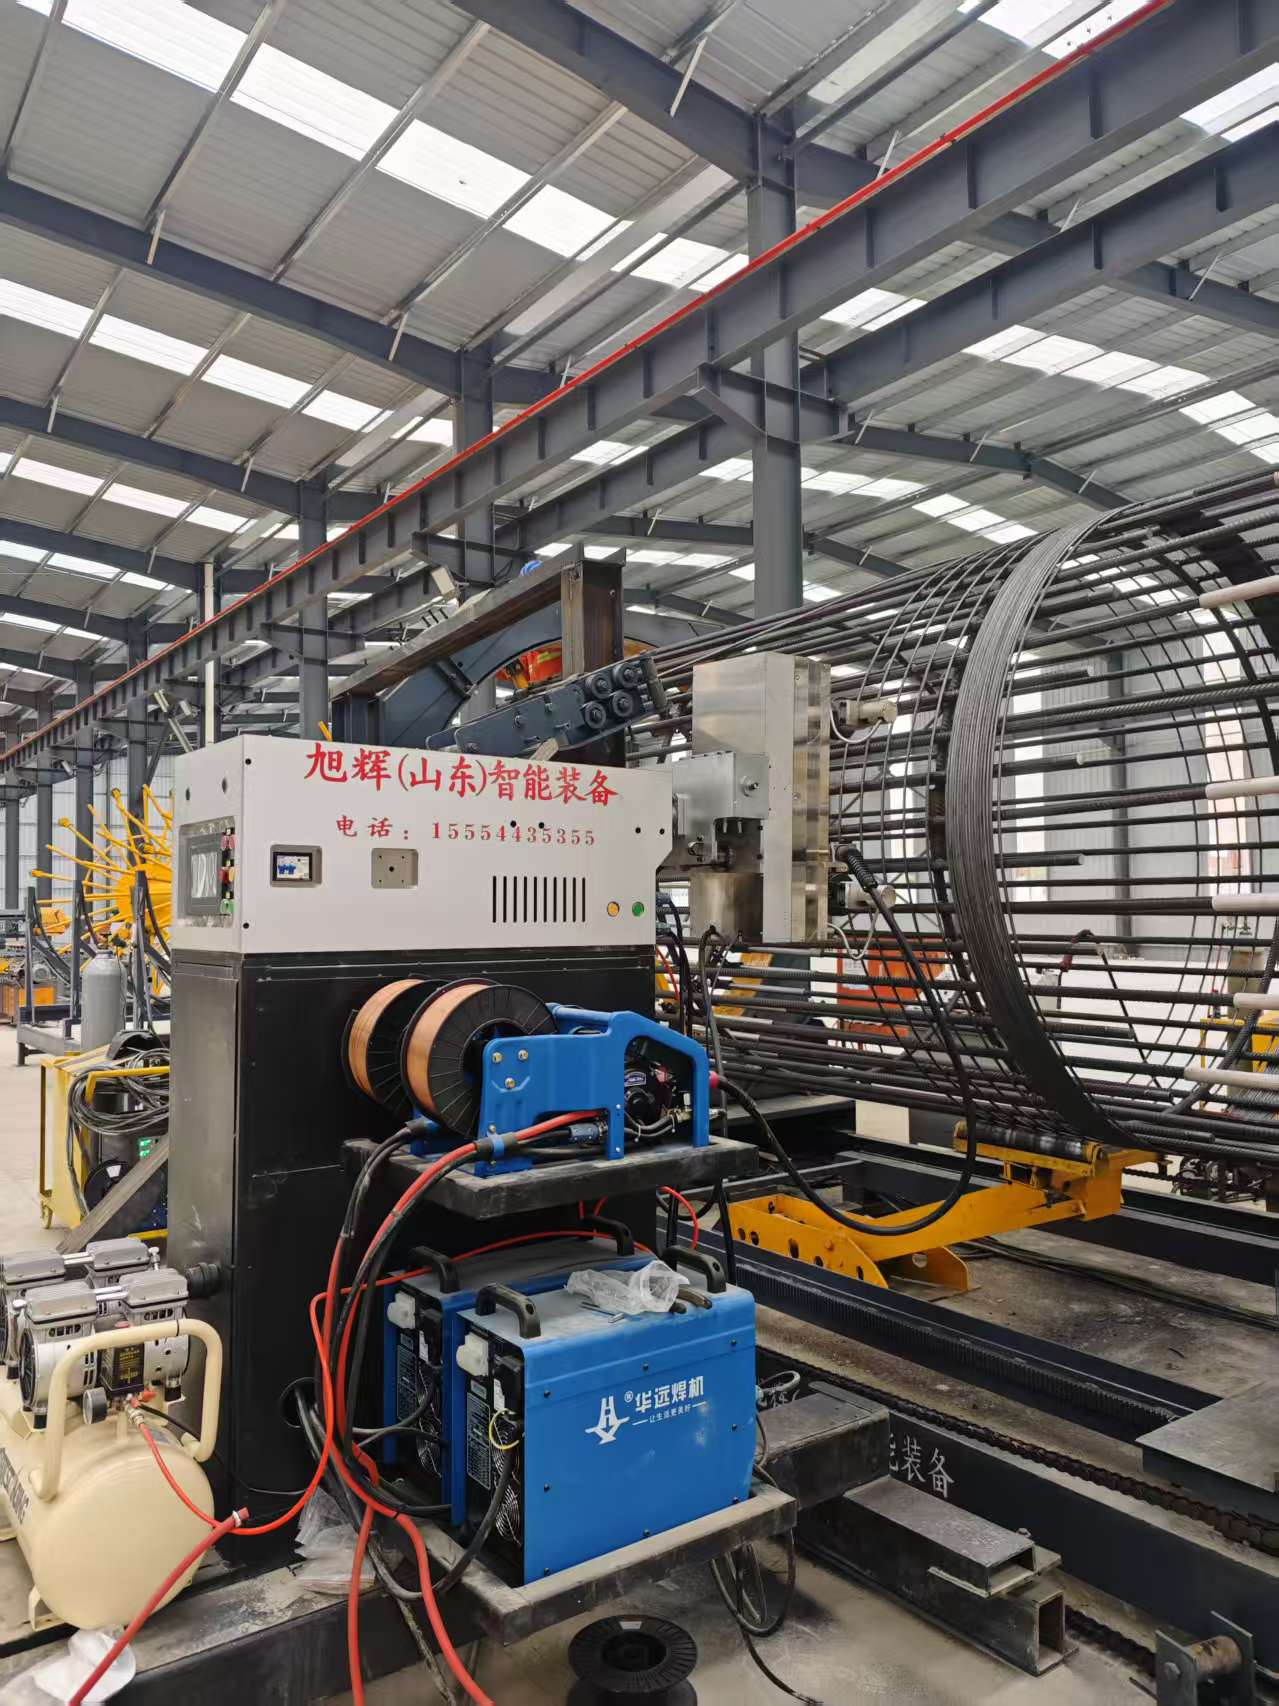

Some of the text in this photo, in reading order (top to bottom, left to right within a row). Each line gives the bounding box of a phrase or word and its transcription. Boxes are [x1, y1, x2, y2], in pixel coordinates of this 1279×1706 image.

[304, 742, 619, 806] 旭辉(山东)智能装备
[431, 821, 595, 846] 15554435355
[635, 1375, 704, 1413] 华远焊机
